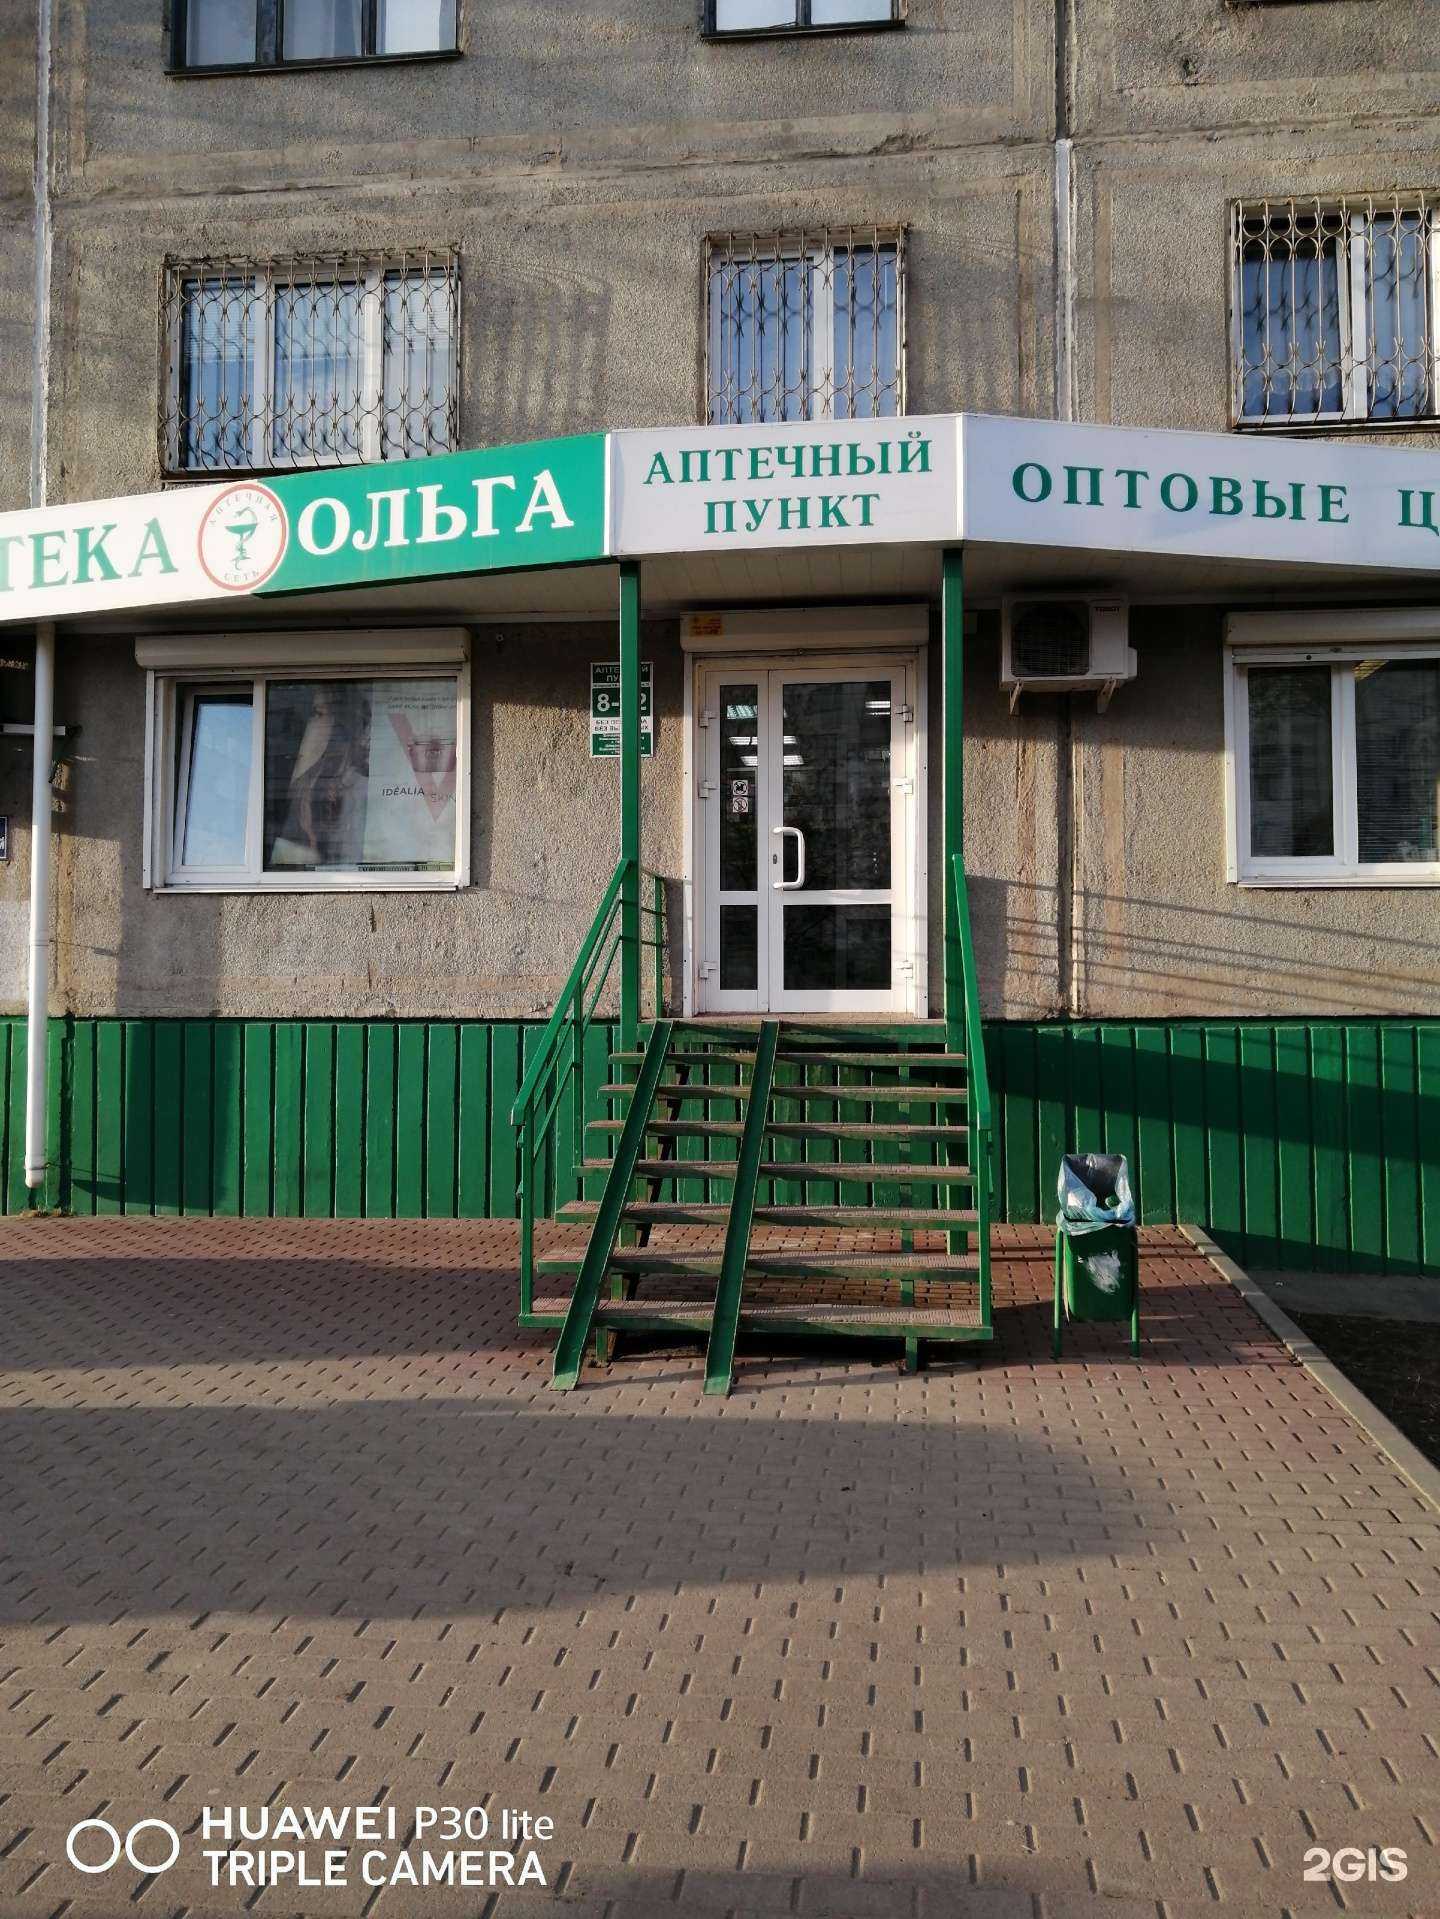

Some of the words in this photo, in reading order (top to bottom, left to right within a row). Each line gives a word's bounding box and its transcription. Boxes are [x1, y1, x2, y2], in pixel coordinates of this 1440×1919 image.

[643, 430, 933, 486] АПТЕЧНЫЙ
[298, 468, 574, 556] ОЛЬГА
[704, 493, 881, 534] ПУНКТ
[1011, 462, 1350, 524] ОПТОВЫЕ
